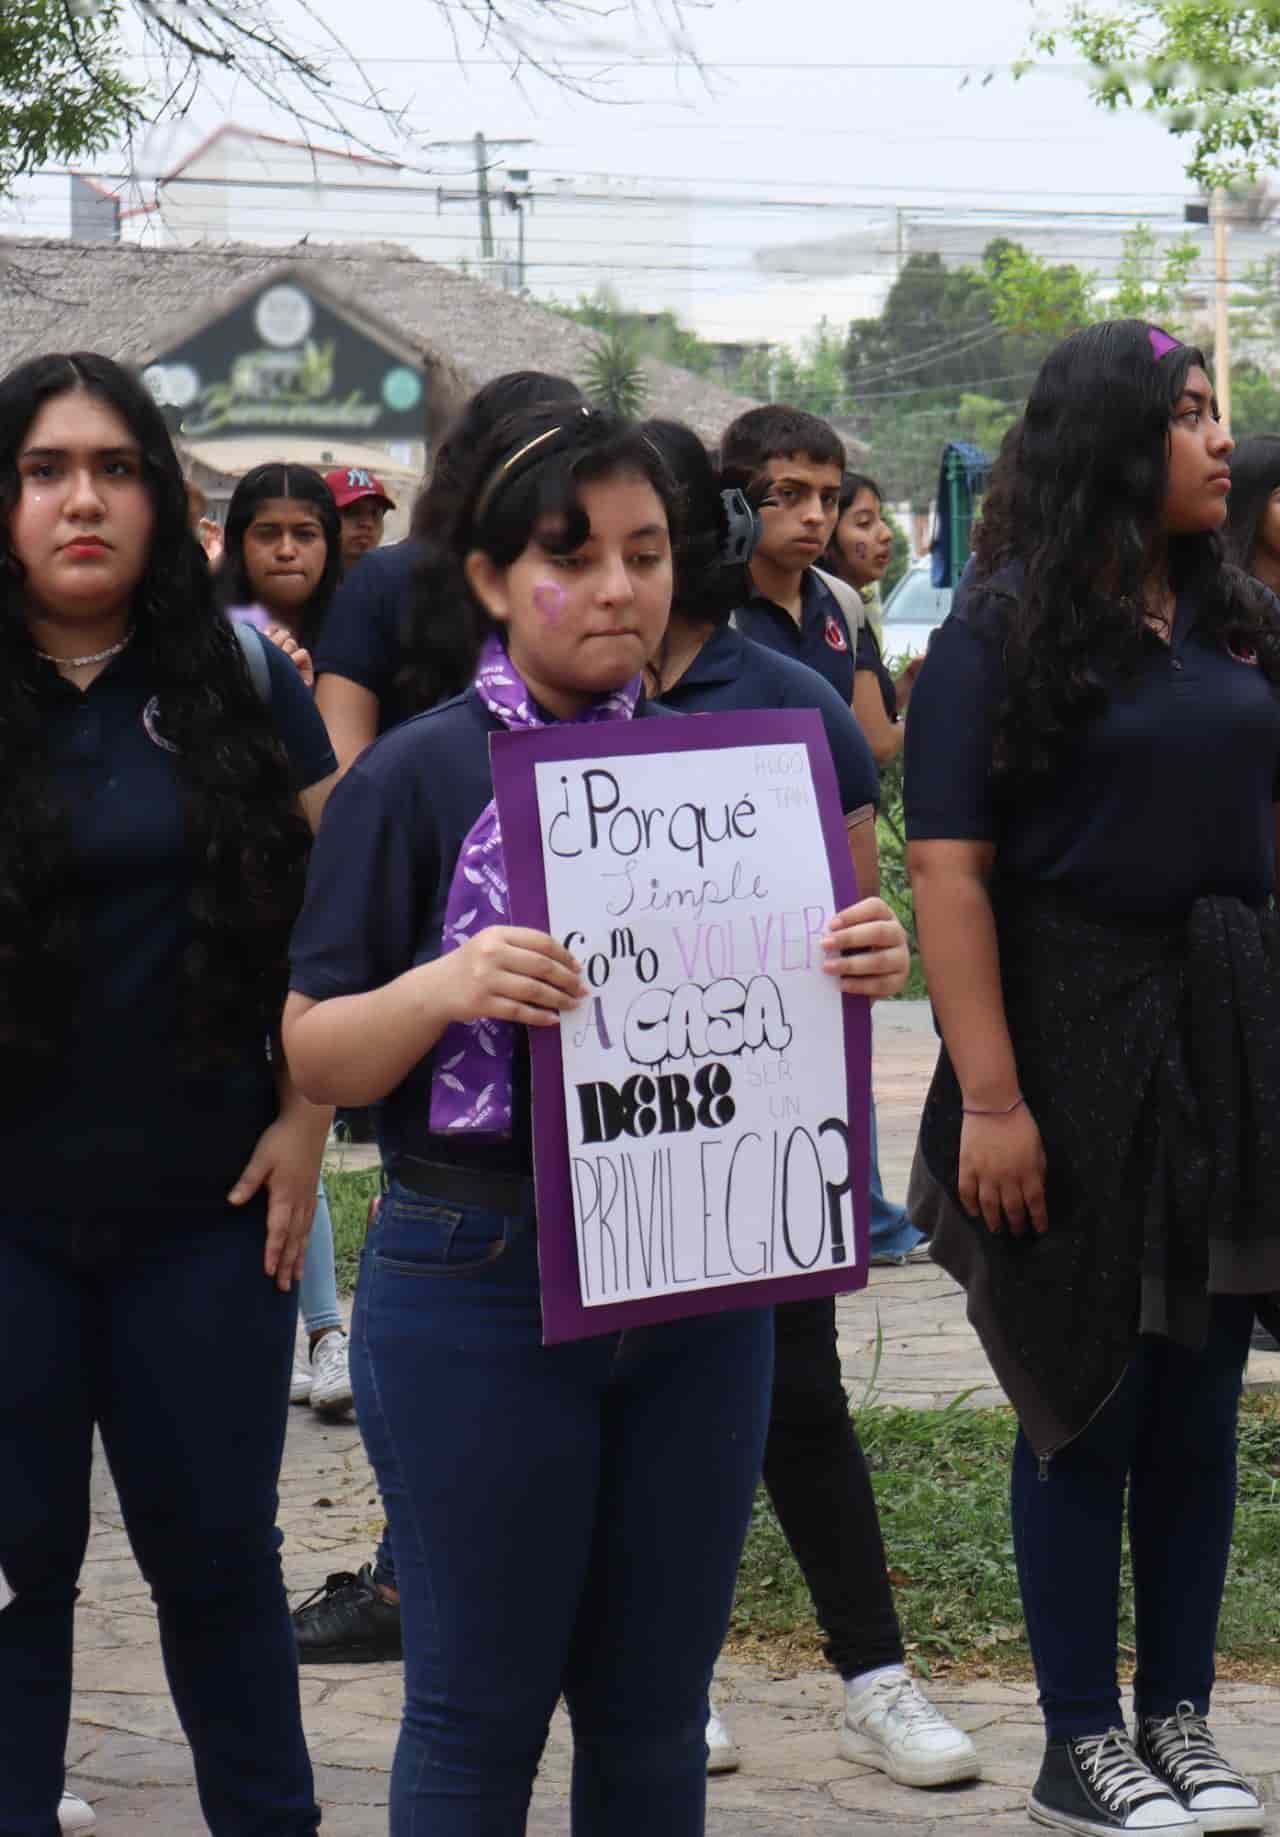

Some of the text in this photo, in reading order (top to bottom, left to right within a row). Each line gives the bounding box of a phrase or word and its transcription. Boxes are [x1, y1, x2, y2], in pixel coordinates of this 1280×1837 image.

[572, 975, 793, 1070] A CASA
[743, 1058, 793, 1089] SER
[767, 1095, 801, 1121] UN
[572, 1117, 852, 1301] PRIVILEGIO?
